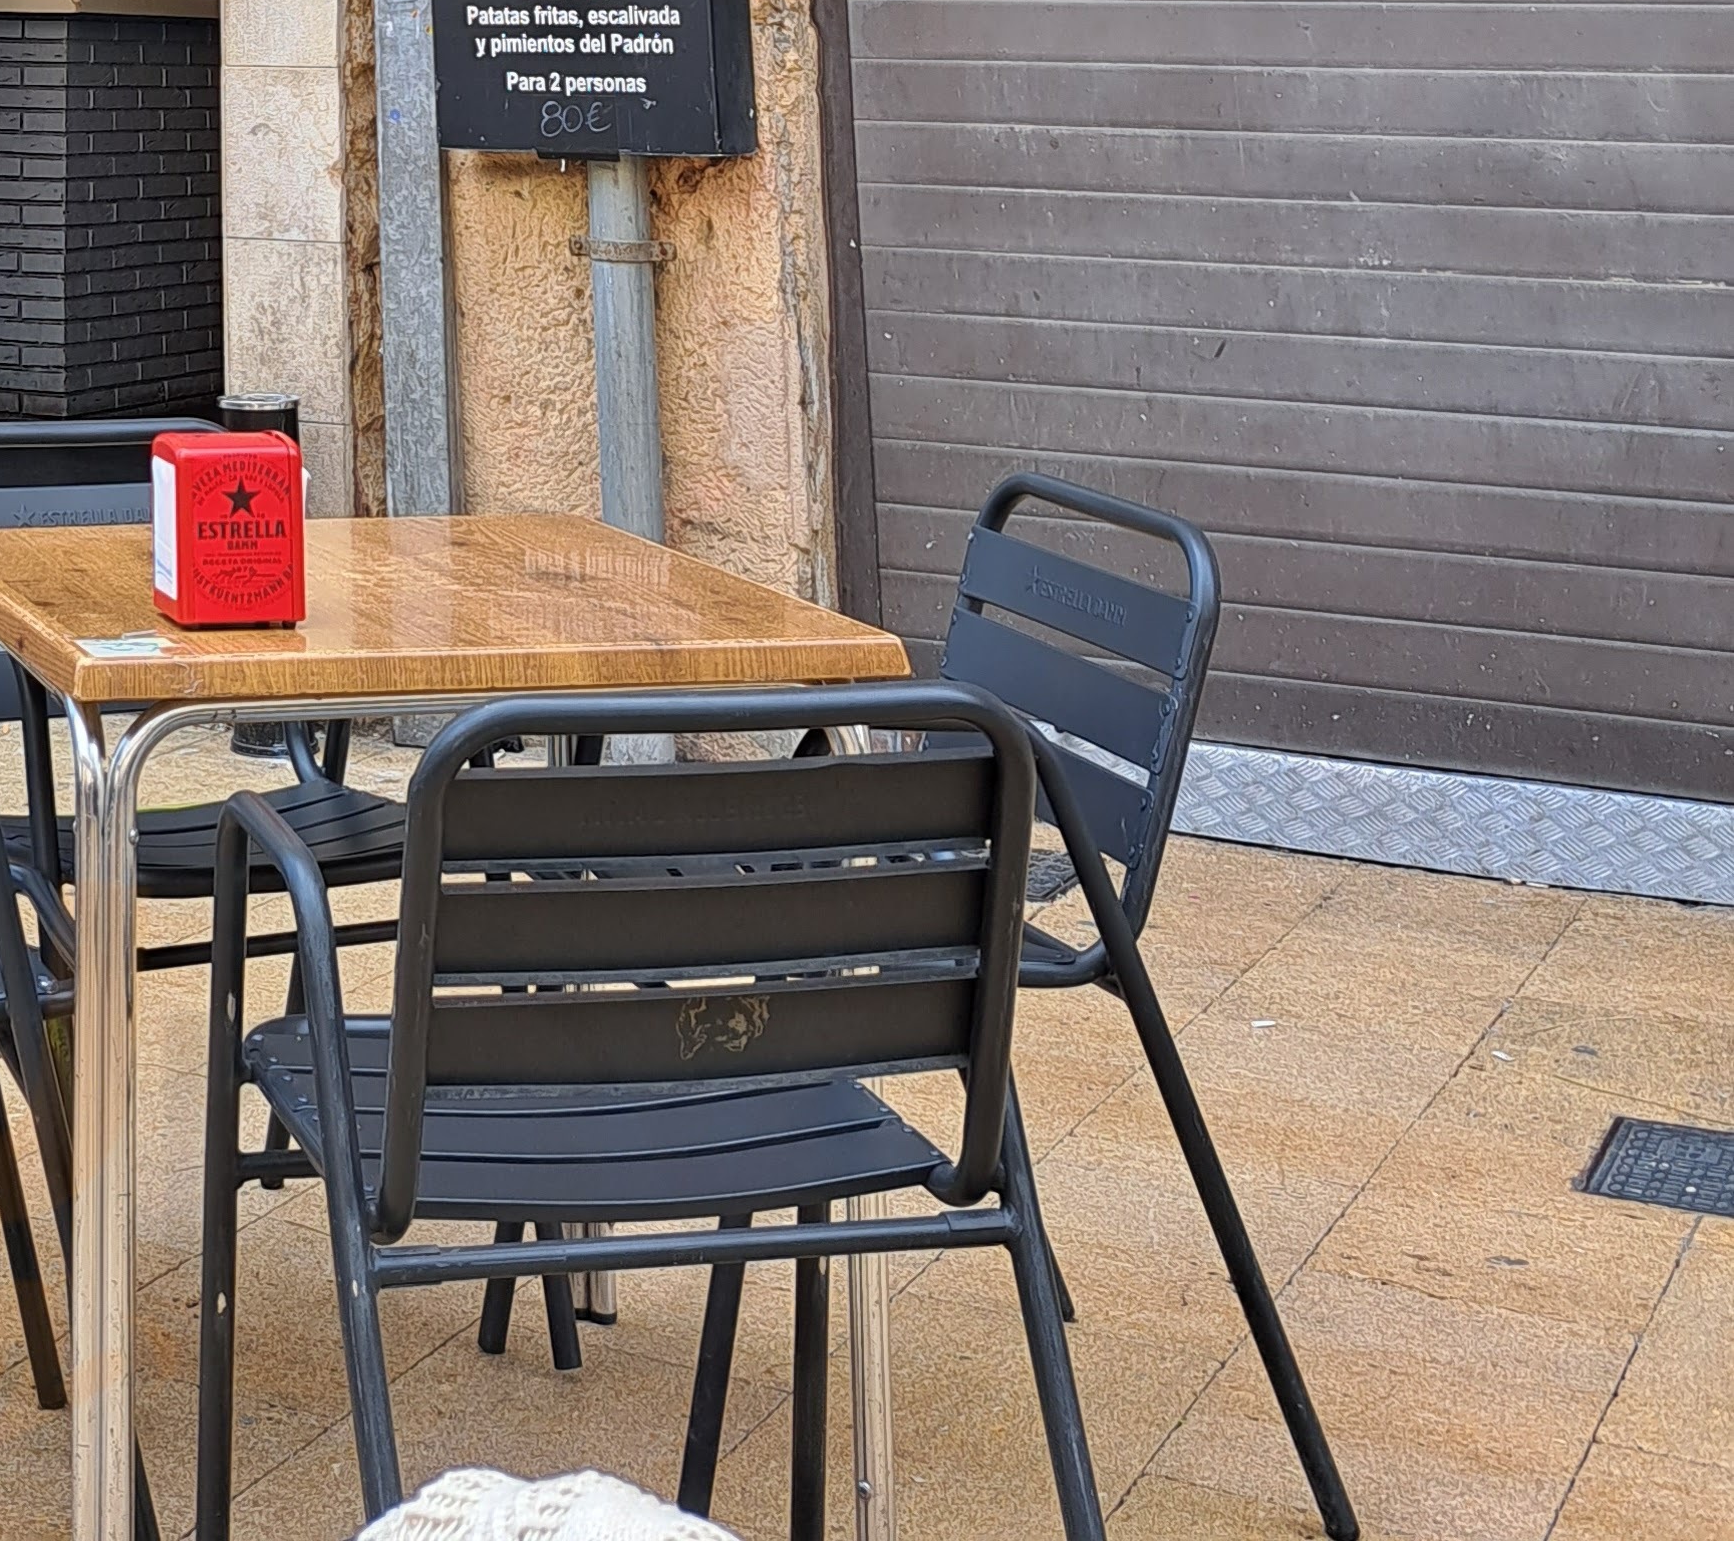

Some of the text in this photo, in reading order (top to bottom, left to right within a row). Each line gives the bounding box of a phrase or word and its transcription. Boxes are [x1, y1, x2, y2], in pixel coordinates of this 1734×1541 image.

[466, 4, 681, 29] Patatas fritas, escalivada
[474, 32, 674, 58] y pimientos del Padrón
[506, 71, 647, 97] Para 2 personas
[197, 519, 287, 541] ESTRELLA
[227, 540, 258, 551] DAMM
